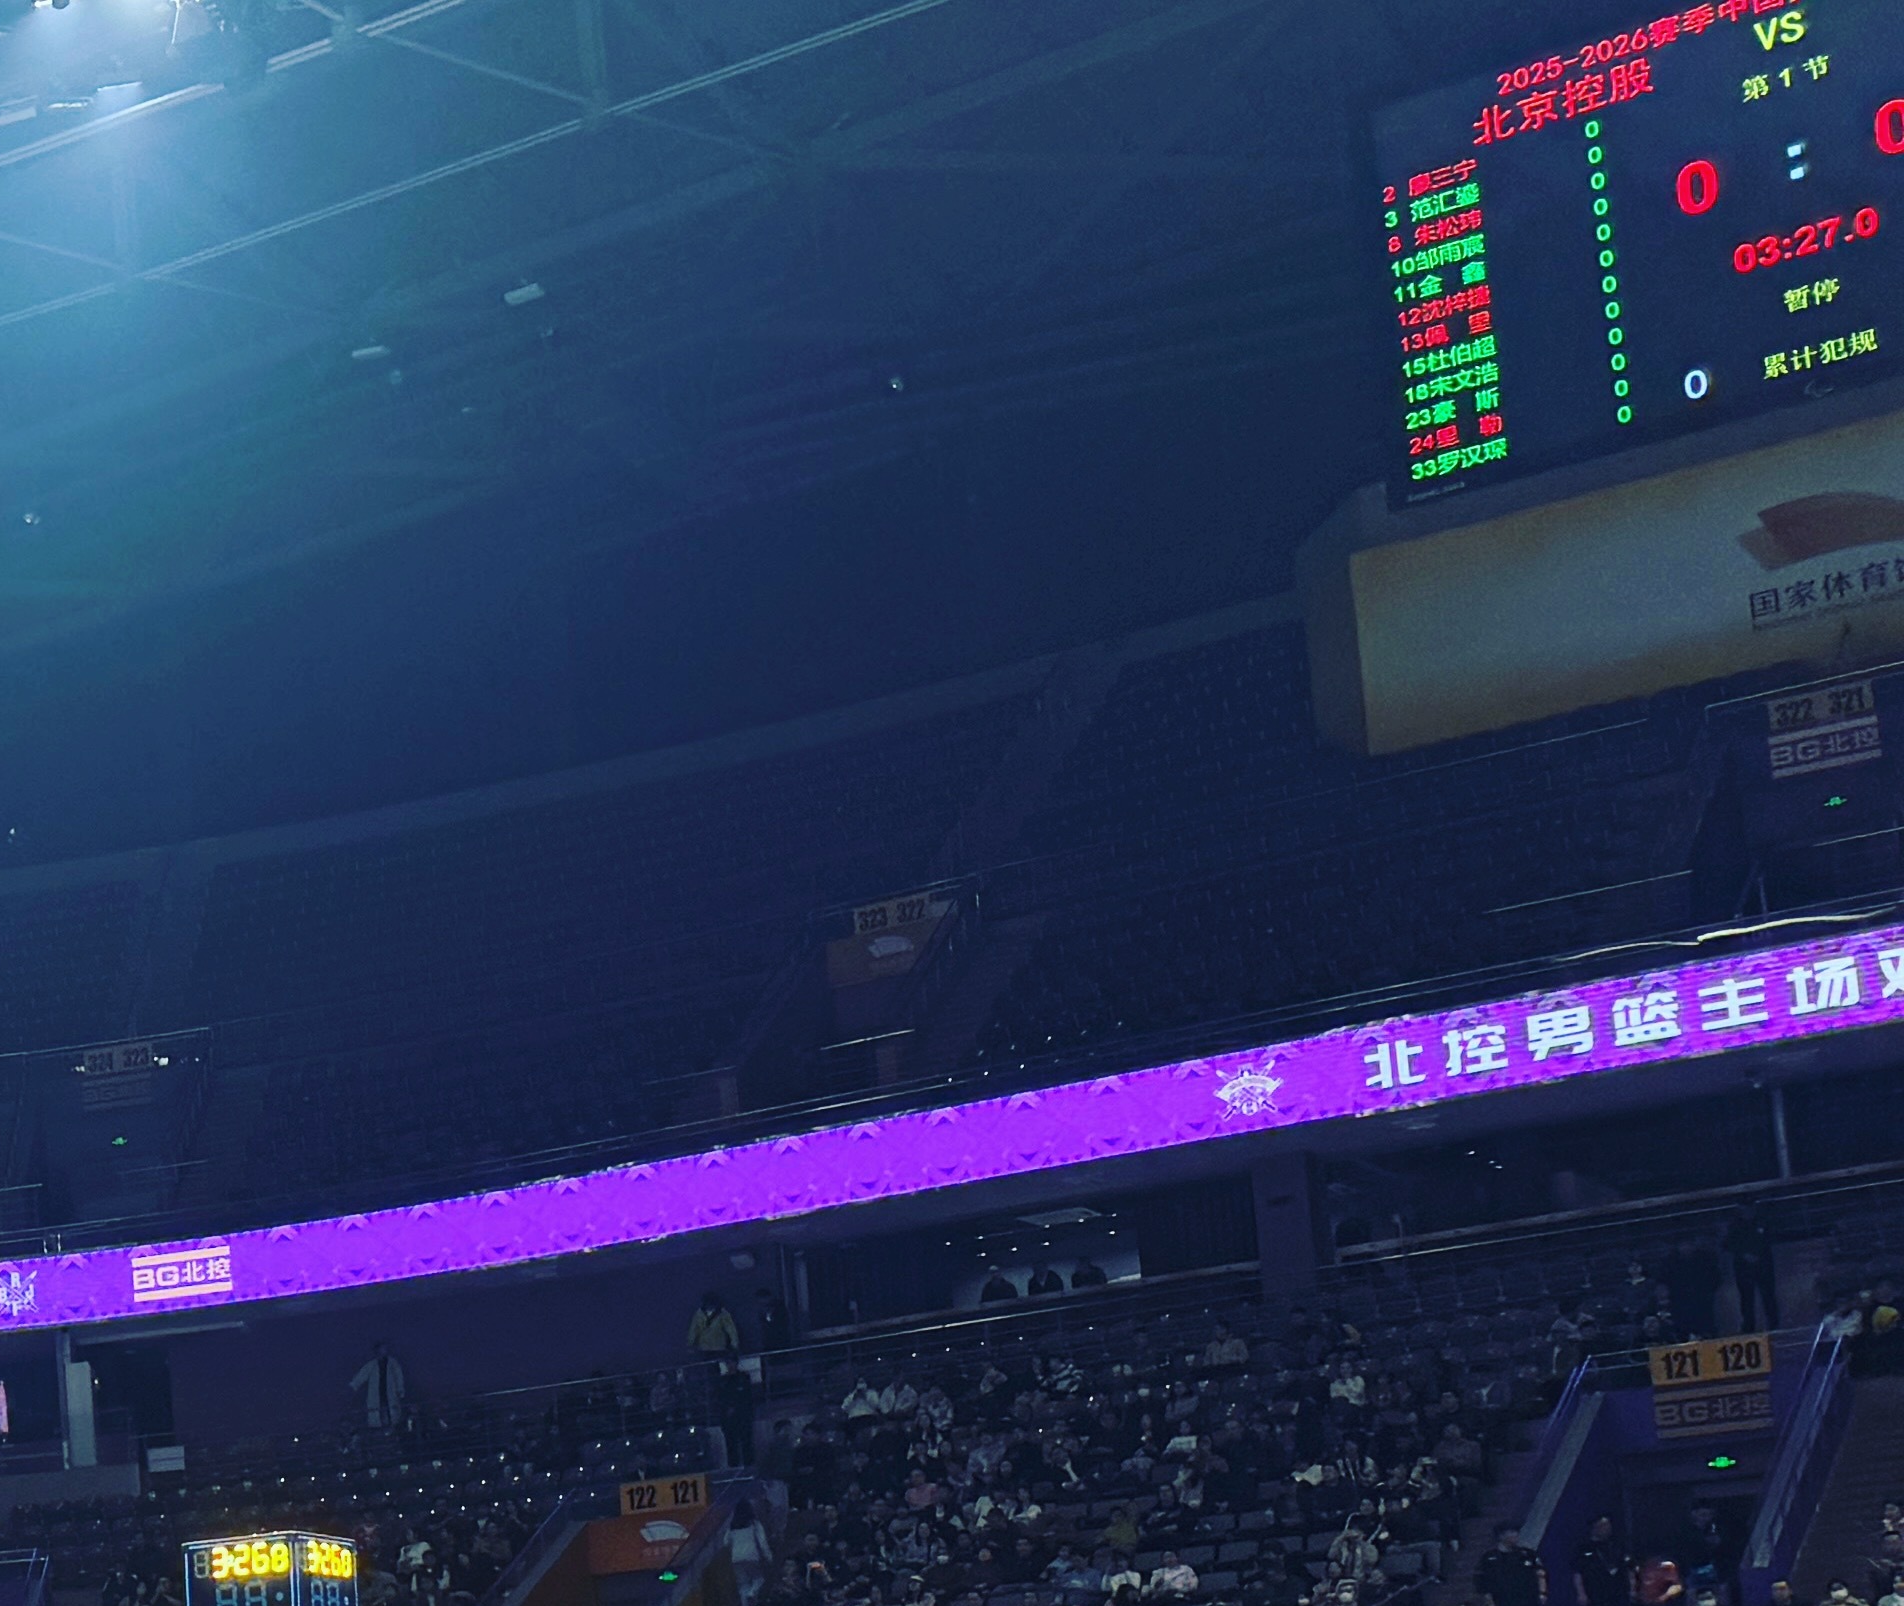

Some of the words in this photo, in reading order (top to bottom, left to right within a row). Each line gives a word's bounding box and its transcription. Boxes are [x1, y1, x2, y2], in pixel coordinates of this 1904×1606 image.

[1754, 11, 1805, 51] VS
[1474, 57, 1654, 145] 北京控股
[1585, 120, 1598, 138] 0
[1874, 98, 1904, 154] 0
[1588, 146, 1601, 164] 0
[1591, 172, 1604, 190] 0
[1676, 160, 1718, 215] 0
[1594, 198, 1607, 216] 0
[1597, 223, 1610, 241] 0
[1733, 207, 1879, 274] 03:27.0
[1600, 249, 1613, 267] 0
[1602, 275, 1615, 293] 0
[1783, 278, 1840, 313] 暂停
[1605, 301, 1618, 319] 0
[1609, 327, 1622, 345] 0
[1612, 353, 1625, 371] 0
[1762, 329, 1878, 381] 累计犯规
[1614, 379, 1627, 397] 0
[1683, 369, 1709, 399] 0
[1617, 405, 1630, 423] 0
[132, 1255, 232, 1292] BG北控
[1661, 1350, 1700, 1379] 121
[1718, 1342, 1761, 1371] 120
[626, 1485, 657, 1510] 122
[670, 1480, 699, 1505] 121
